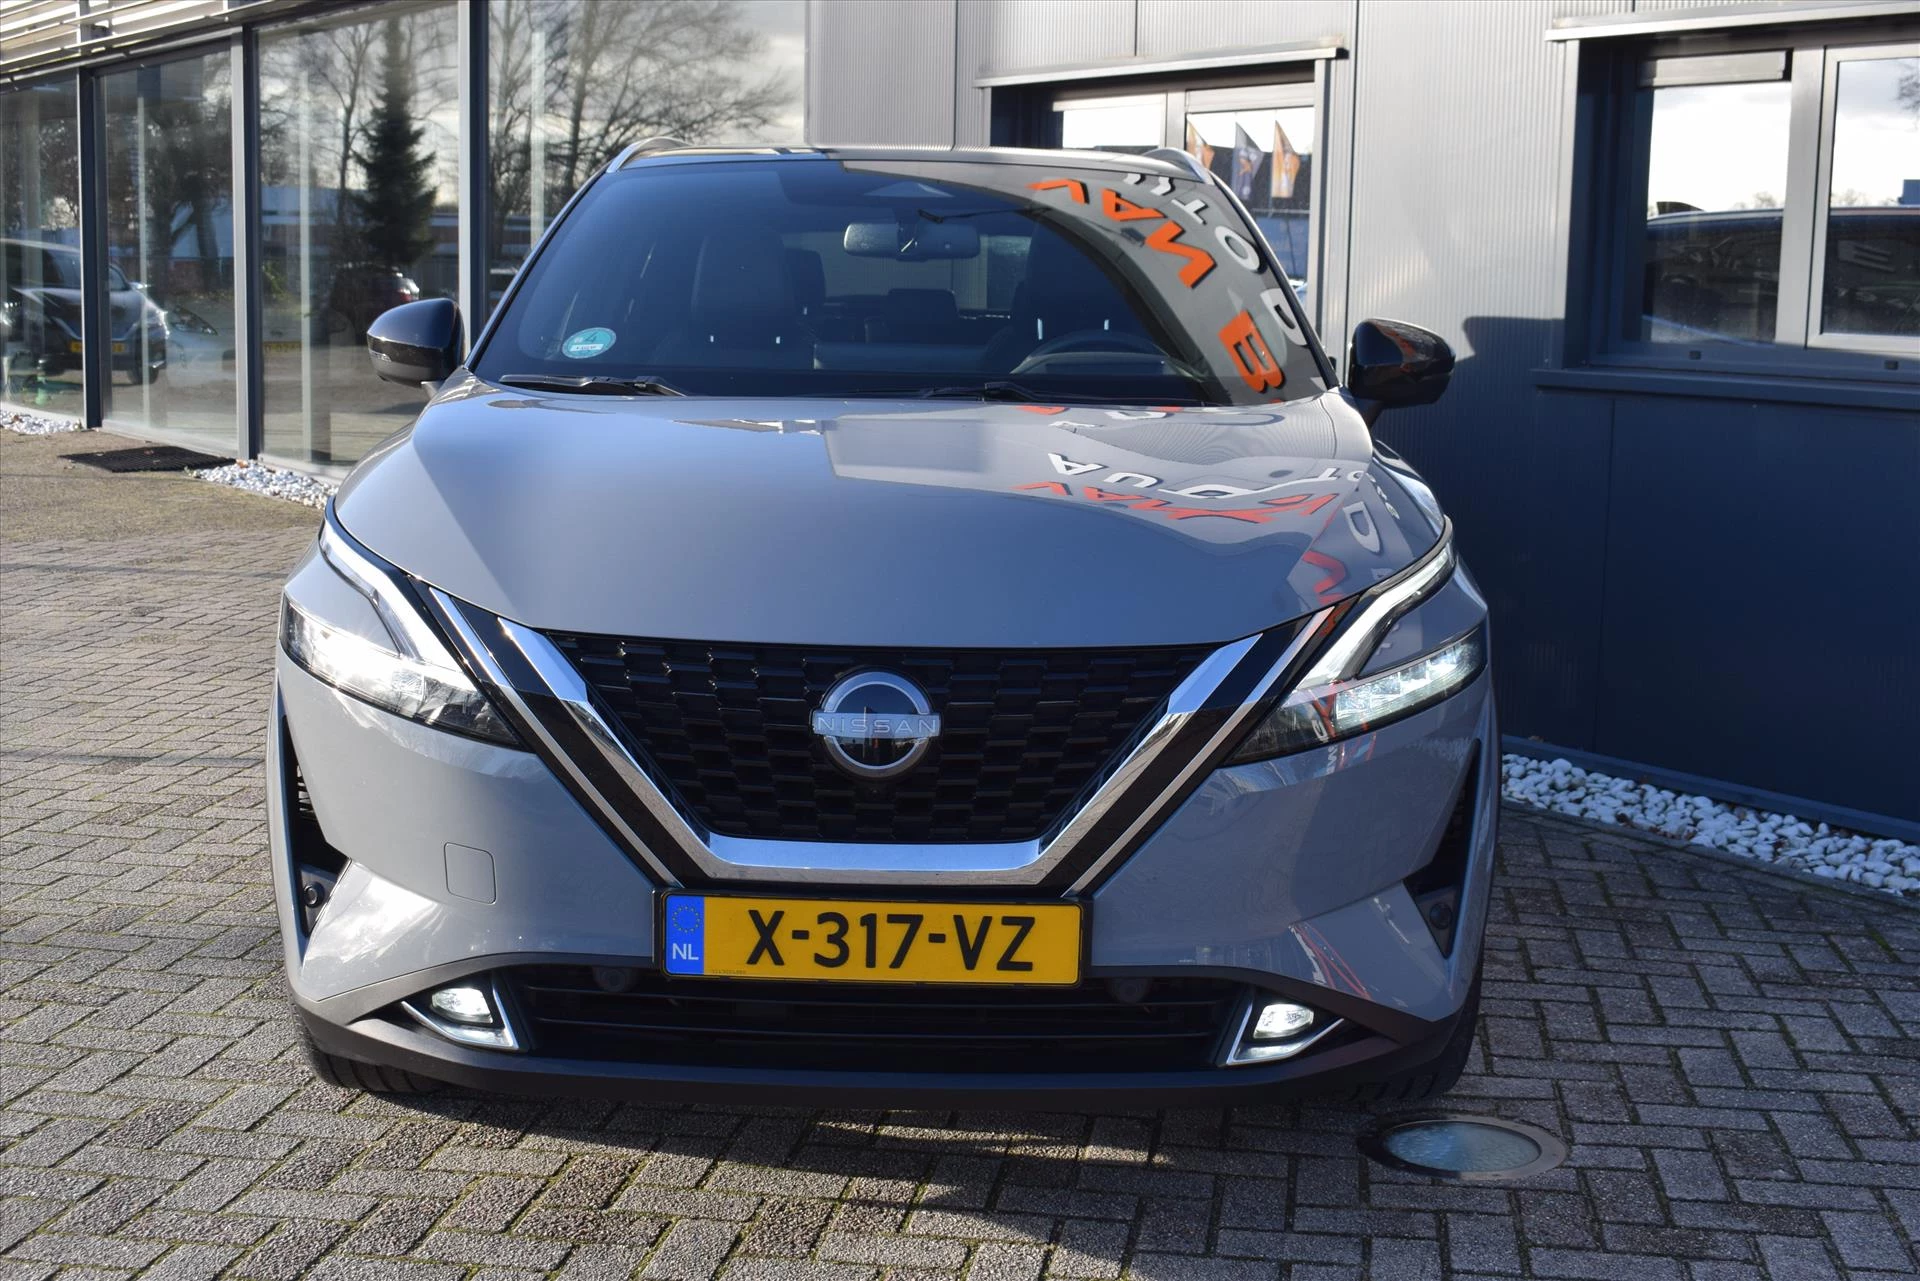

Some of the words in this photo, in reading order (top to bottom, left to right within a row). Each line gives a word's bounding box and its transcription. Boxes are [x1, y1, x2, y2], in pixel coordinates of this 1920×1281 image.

[817, 717, 938, 733] NISSAN
[746, 909, 1036, 972] X-317-VZ
[672, 942, 699, 961] NL
